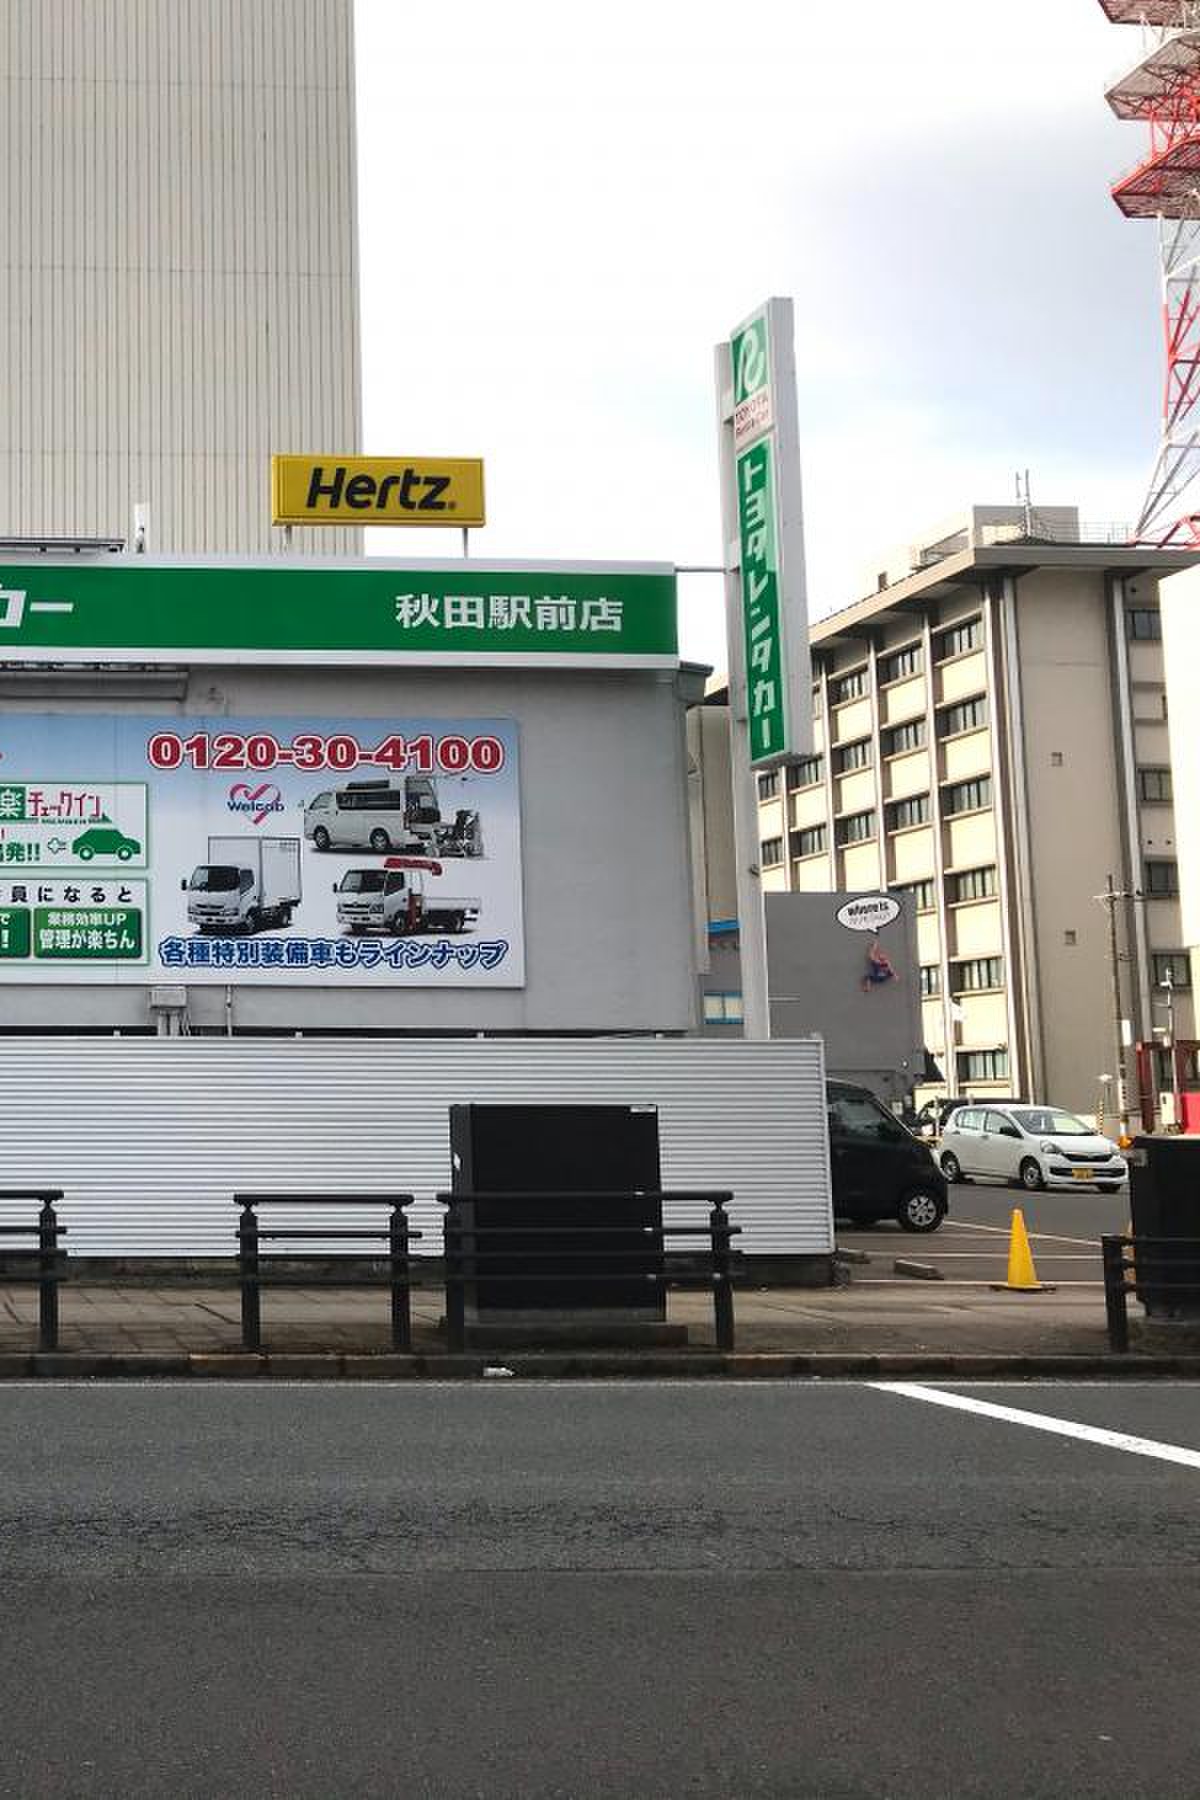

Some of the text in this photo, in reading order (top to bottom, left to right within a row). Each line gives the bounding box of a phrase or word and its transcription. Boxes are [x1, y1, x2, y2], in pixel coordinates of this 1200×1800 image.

[394, 593, 625, 632] 秋田駅前店
[743, 458, 777, 750] トヨタレンタカー
[147, 733, 505, 772] 0120-30-4100
[227, 800, 285, 812] Welcab
[39, 930, 135, 949] 管理が楽ちん
[161, 938, 506, 967] 各種特別装備車もラインナップ
